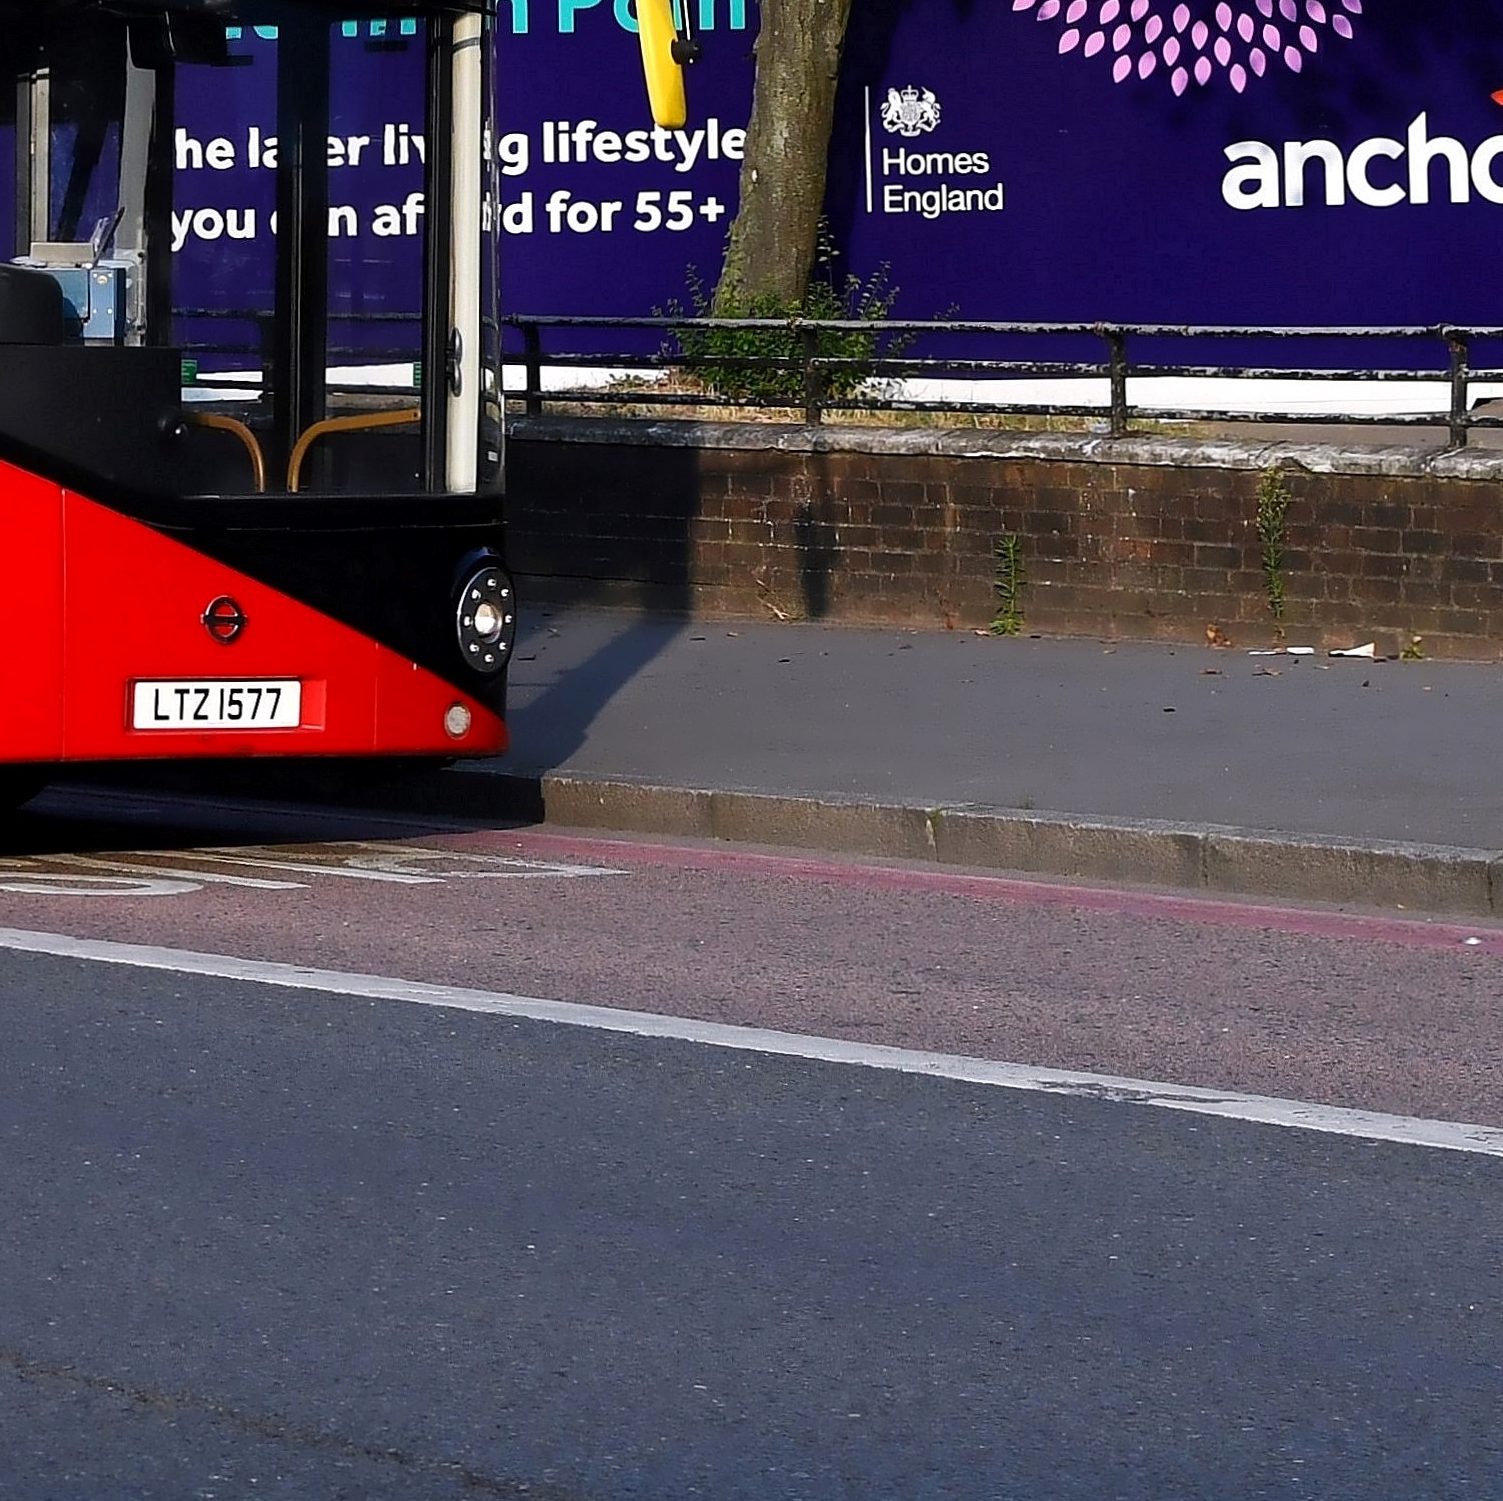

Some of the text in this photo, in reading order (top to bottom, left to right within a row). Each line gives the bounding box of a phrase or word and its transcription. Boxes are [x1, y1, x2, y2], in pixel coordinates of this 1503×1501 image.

[248, 126, 370, 168] laer
[542, 118, 747, 172] lifestyle
[883, 148, 990, 176] Homes
[883, 183, 1003, 219] England
[171, 208, 256, 252] you
[545, 190, 622, 233] for
[633, 191, 725, 232] 55+
[154, 688, 282, 720] LTZ 1577
